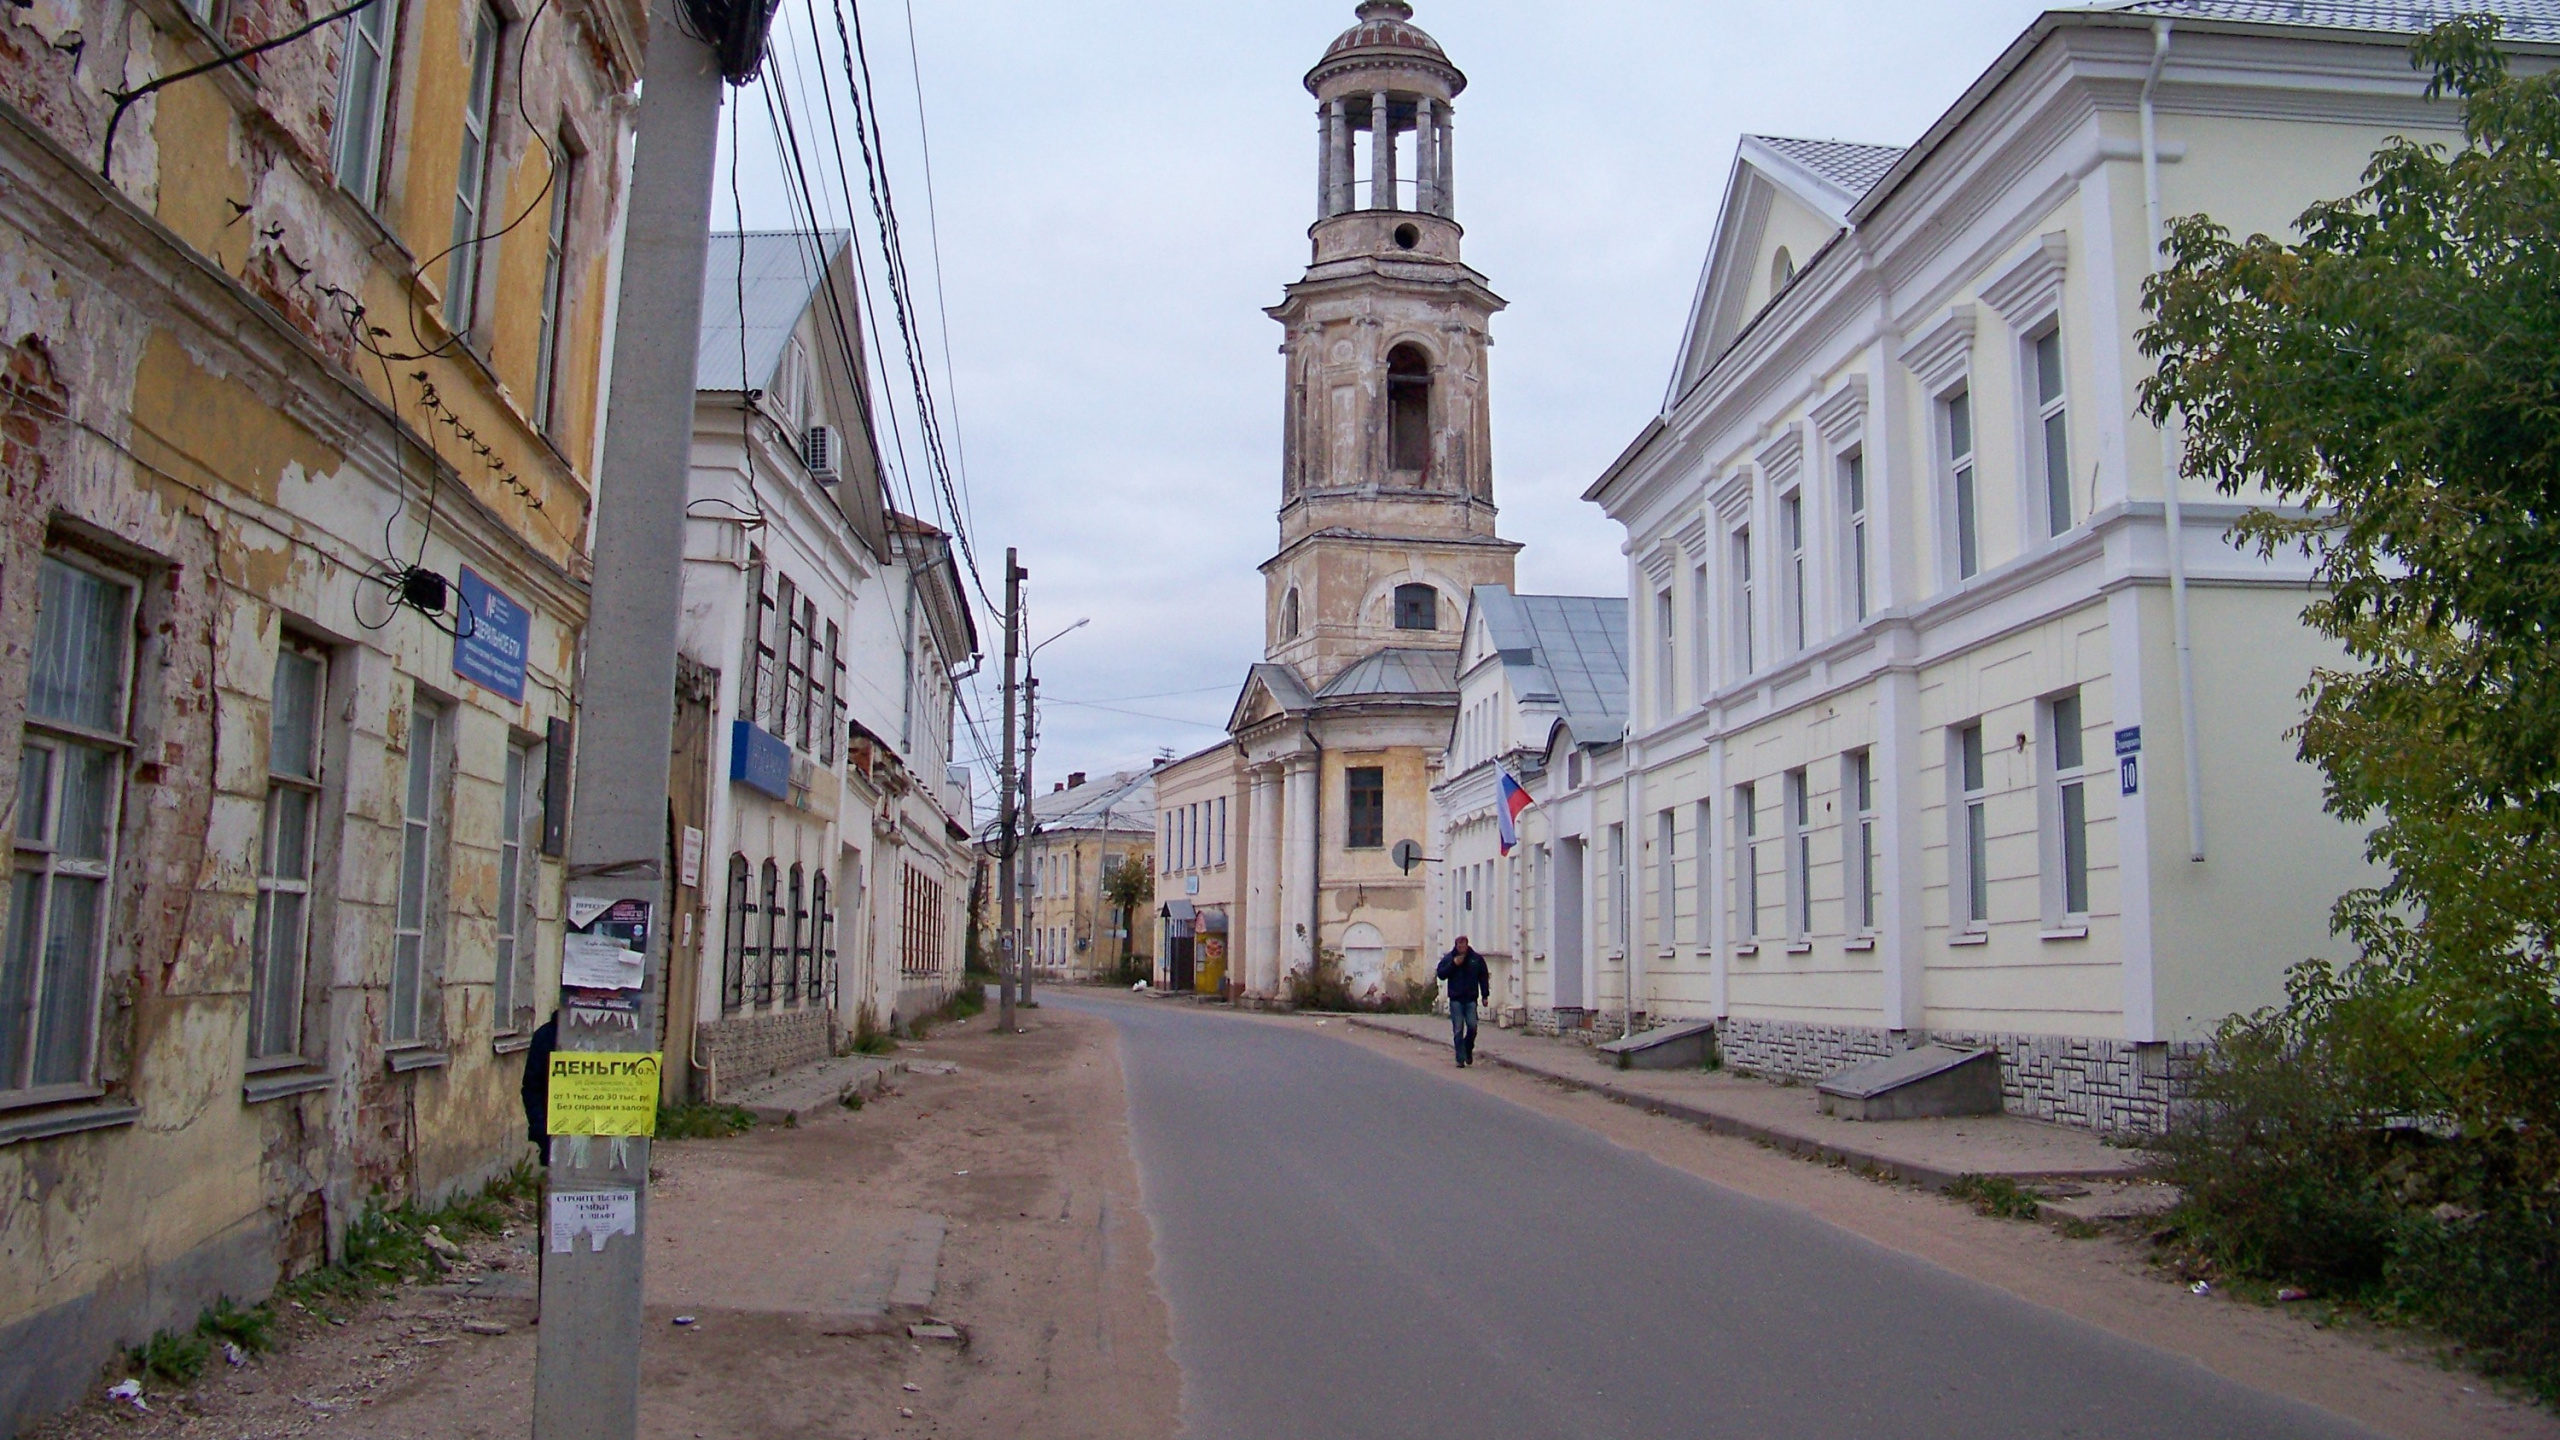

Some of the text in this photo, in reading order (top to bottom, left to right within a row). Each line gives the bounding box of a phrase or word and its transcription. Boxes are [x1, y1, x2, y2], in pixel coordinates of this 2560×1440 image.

[2122, 762, 2136, 788] 10
[552, 1060, 637, 1077] ДЕНЬГИ
[556, 1103, 572, 1111] Без
[574, 1104, 611, 1112] справок
